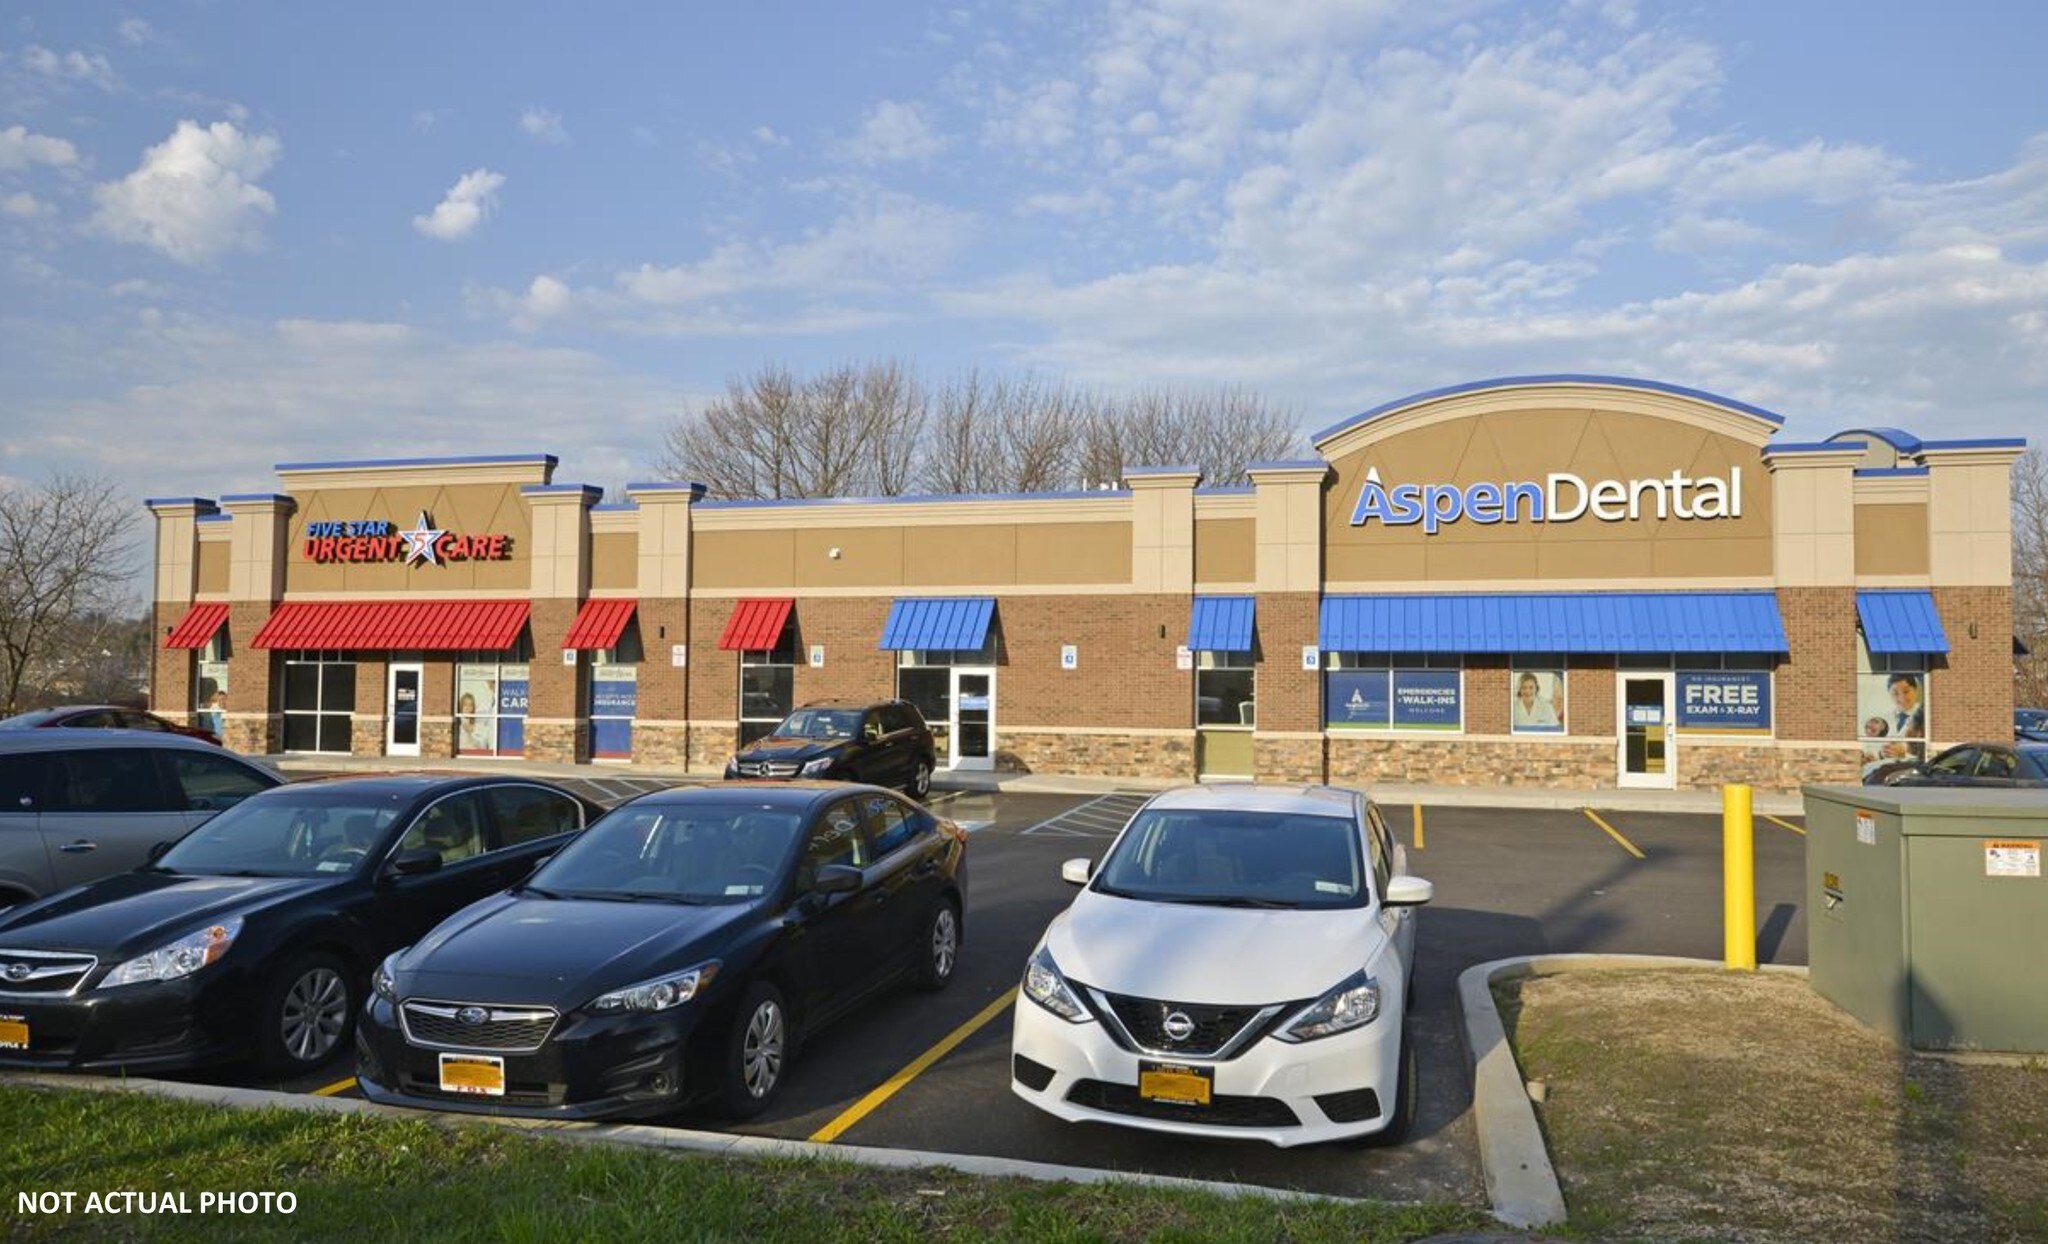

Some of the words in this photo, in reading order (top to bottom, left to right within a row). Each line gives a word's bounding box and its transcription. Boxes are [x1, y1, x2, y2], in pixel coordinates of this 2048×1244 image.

[306, 521, 342, 537] FIVE
[346, 520, 388, 536] STAR
[302, 534, 401, 560] URGENT
[435, 533, 507, 559] CARE
[1402, 696, 1456, 704] WALK-INS
[1686, 684, 1759, 705] FREE
[501, 697, 529, 708] CAR
[1686, 705, 1718, 714] EXAM
[1726, 705, 1760, 714] X-RAY
